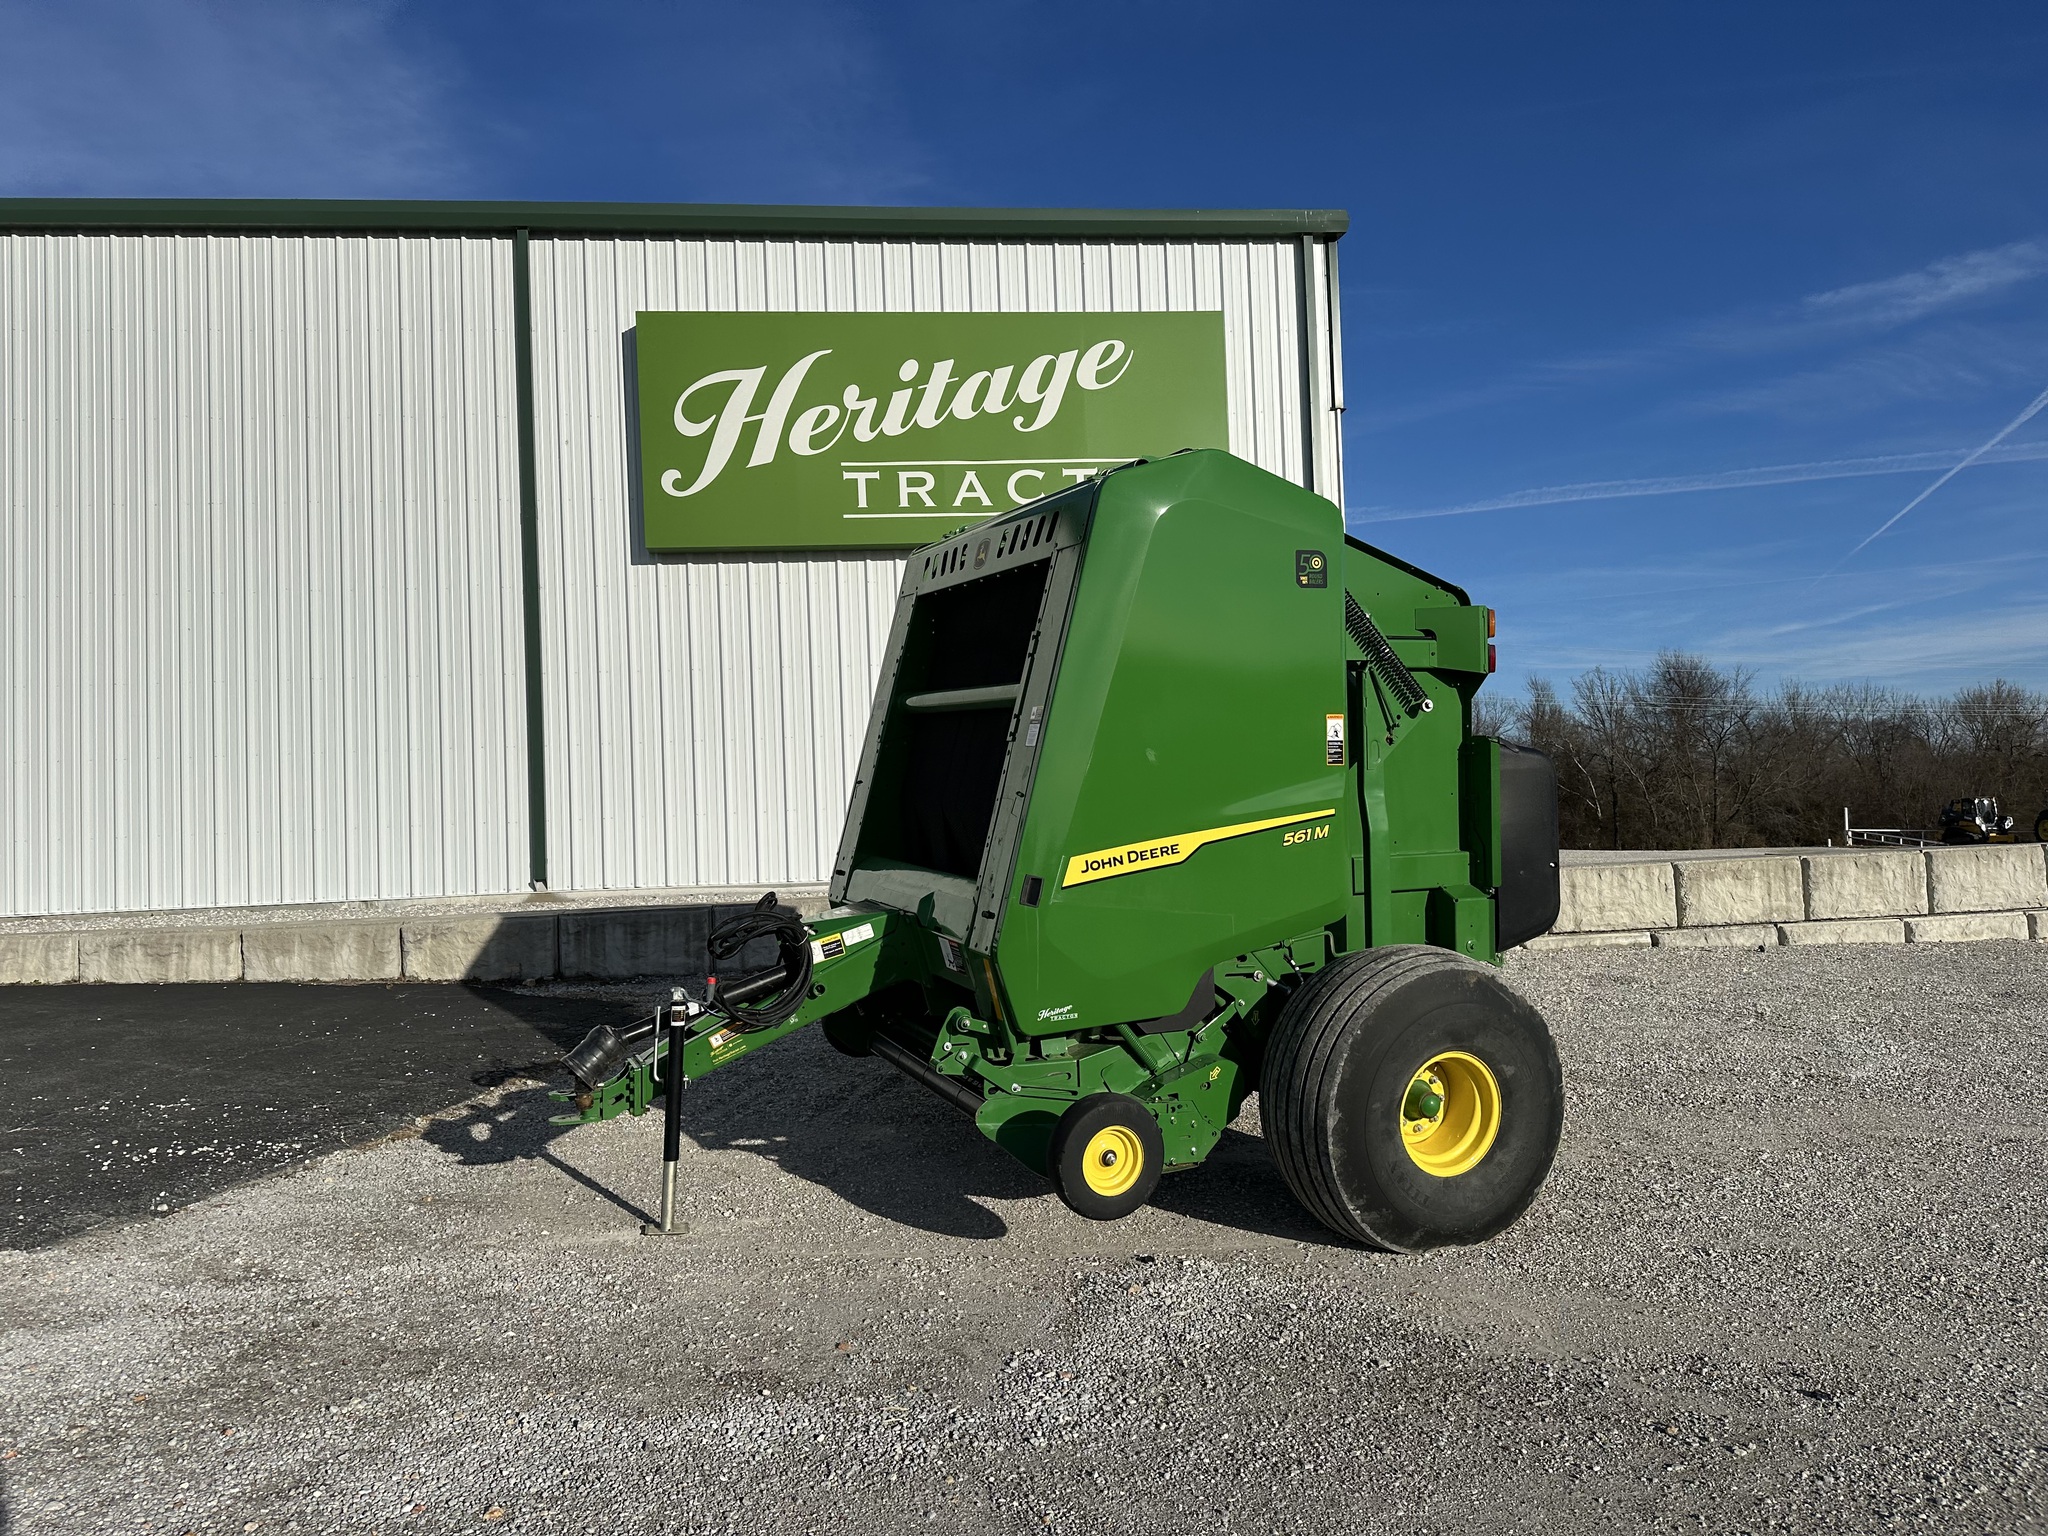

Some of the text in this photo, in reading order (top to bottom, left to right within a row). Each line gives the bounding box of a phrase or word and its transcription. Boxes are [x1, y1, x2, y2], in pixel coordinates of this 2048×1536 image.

[660, 339, 1134, 498] Heritage
[1081, 843, 1180, 873] JOHN DEERE
[1037, 1004, 1073, 1021] Heritage
